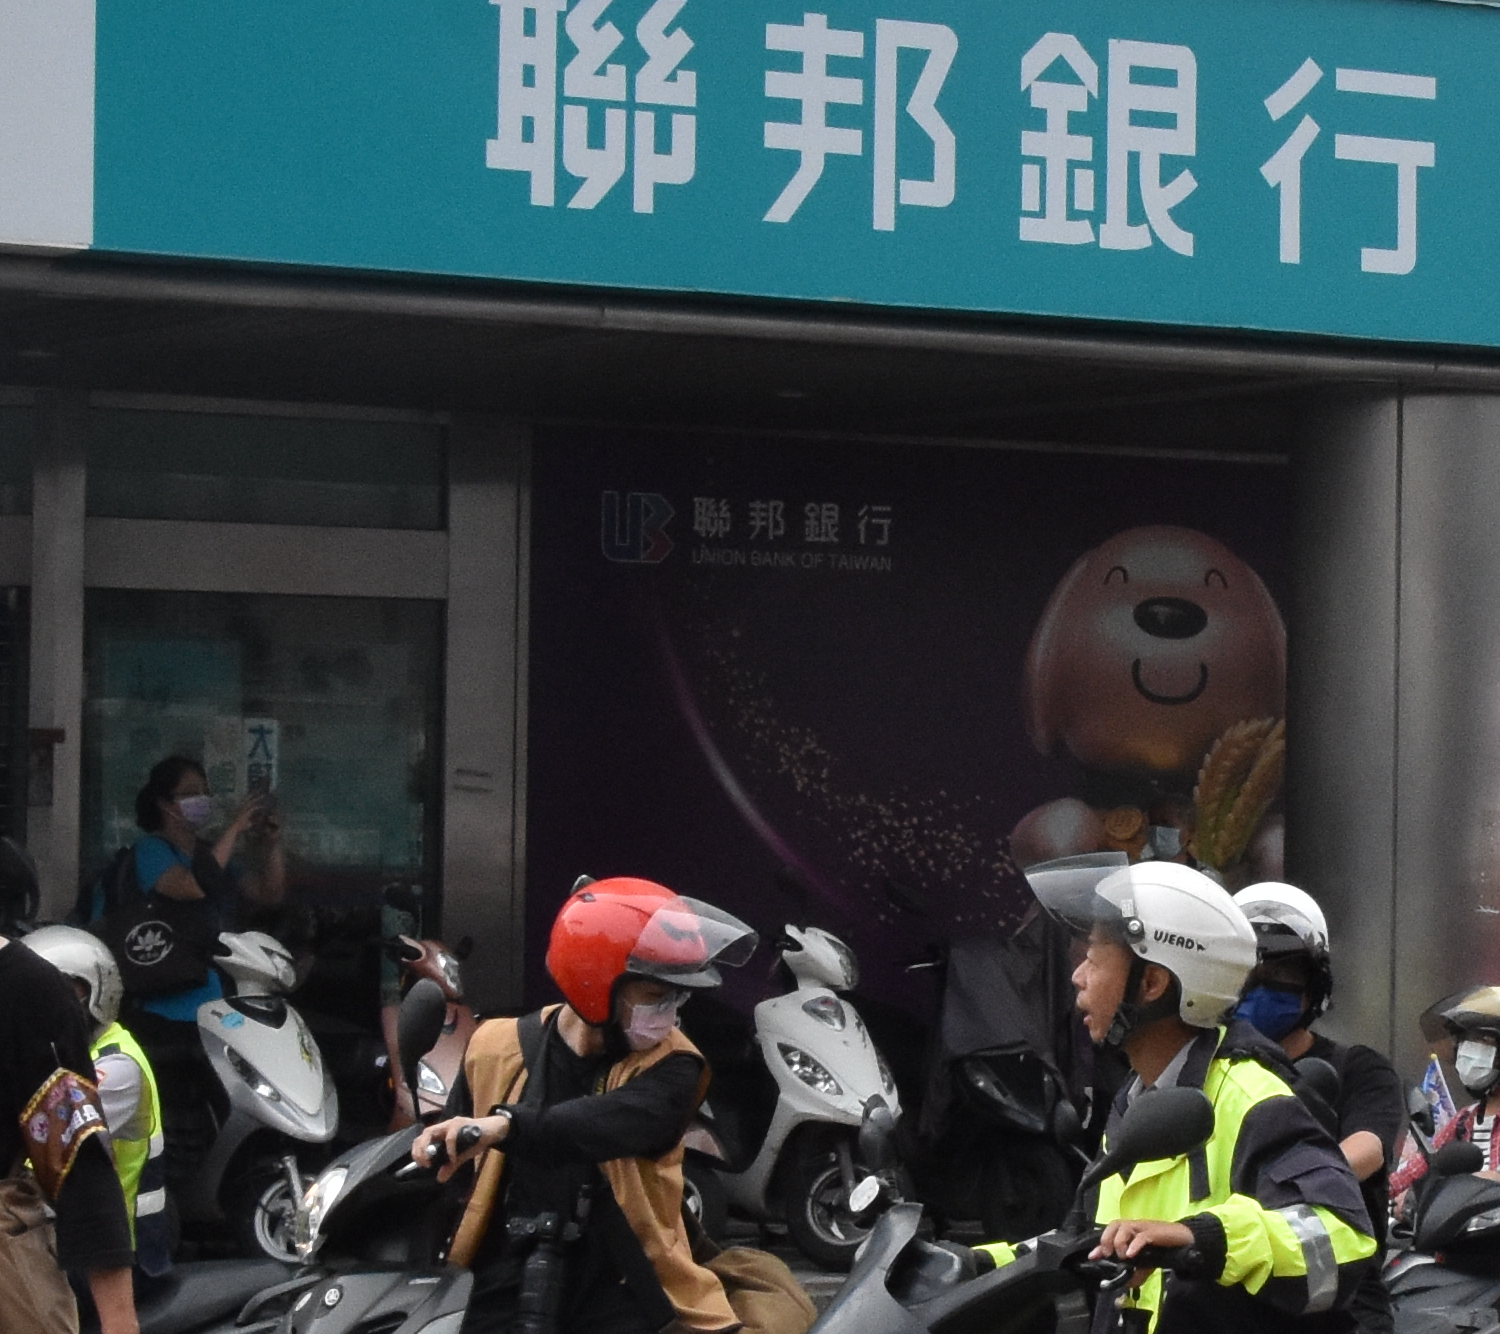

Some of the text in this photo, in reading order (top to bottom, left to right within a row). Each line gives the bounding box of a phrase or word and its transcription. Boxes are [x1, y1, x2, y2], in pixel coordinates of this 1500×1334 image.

[693, 496, 892, 546] 聯邦銀行
[693, 545, 892, 572] UNION BANK OF TAIWAN
